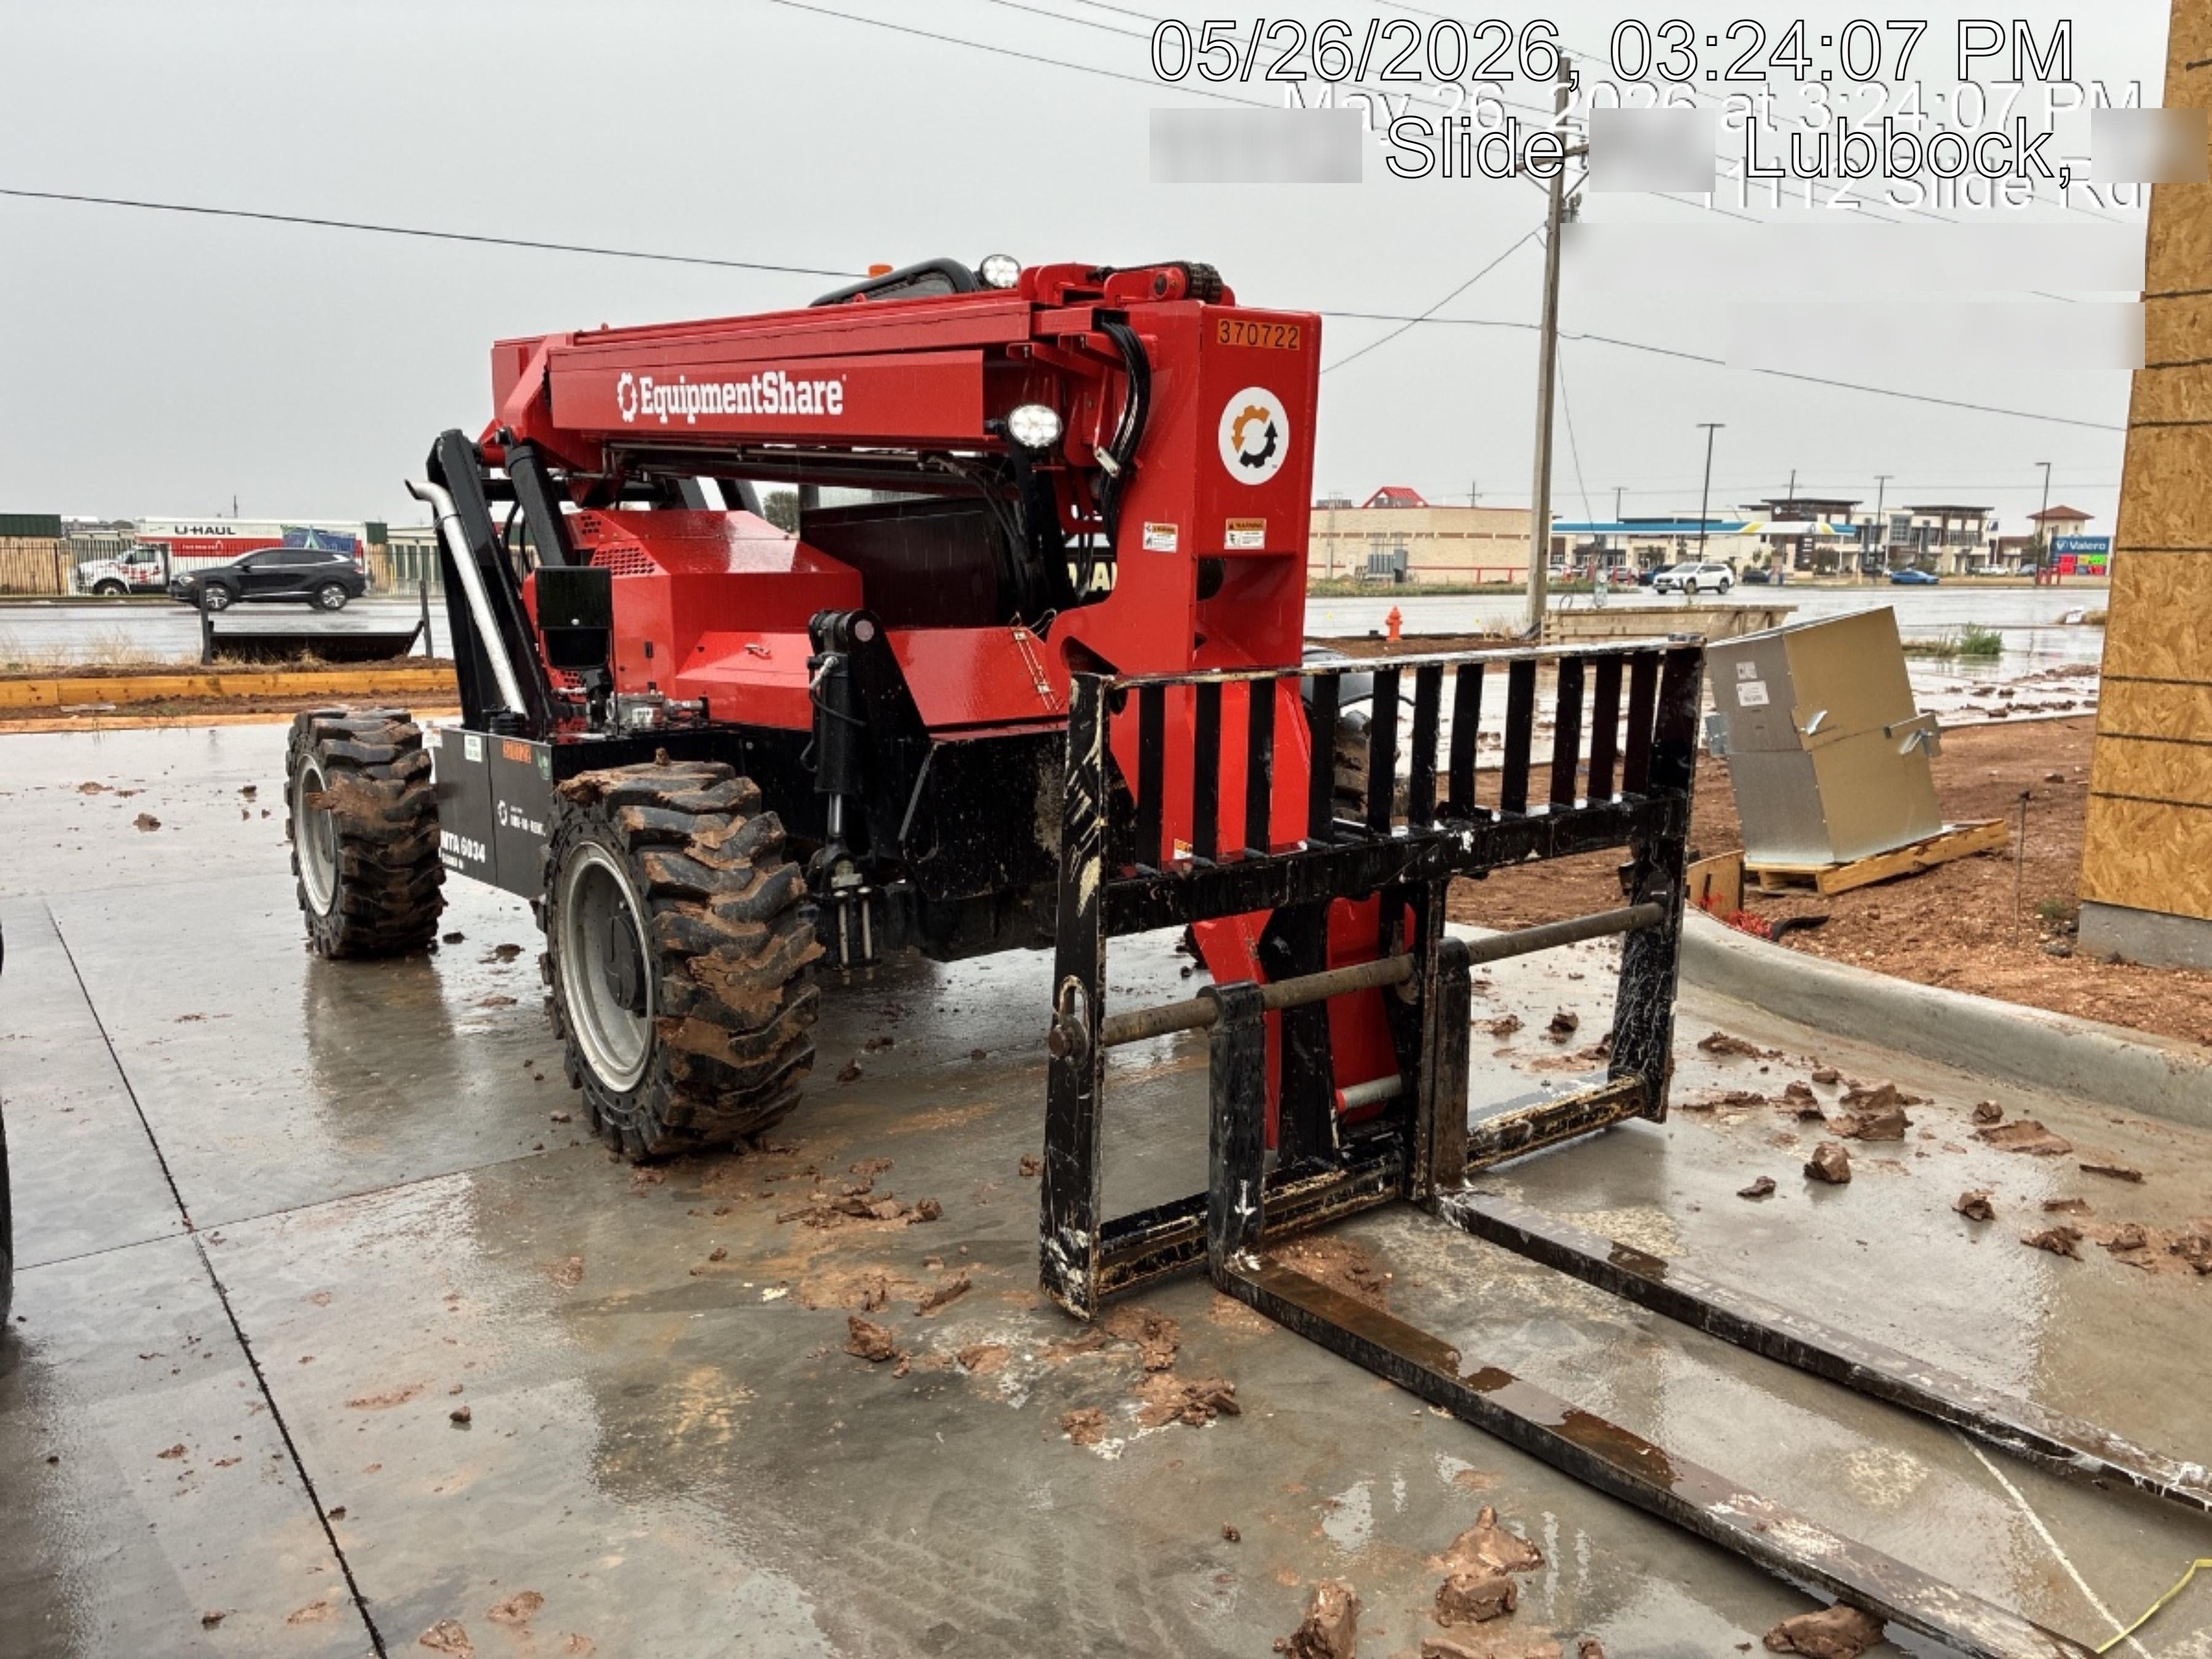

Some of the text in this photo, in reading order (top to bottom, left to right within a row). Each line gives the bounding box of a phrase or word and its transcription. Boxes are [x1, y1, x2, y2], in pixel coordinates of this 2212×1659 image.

[1219, 320, 1300, 348] 370722
[639, 371, 843, 424] EquipmentShare
[175, 525, 236, 535] U-HAUL
[2069, 541, 2106, 550] Valero
[441, 830, 460, 854] MTA
[460, 836, 485, 863] 6034
